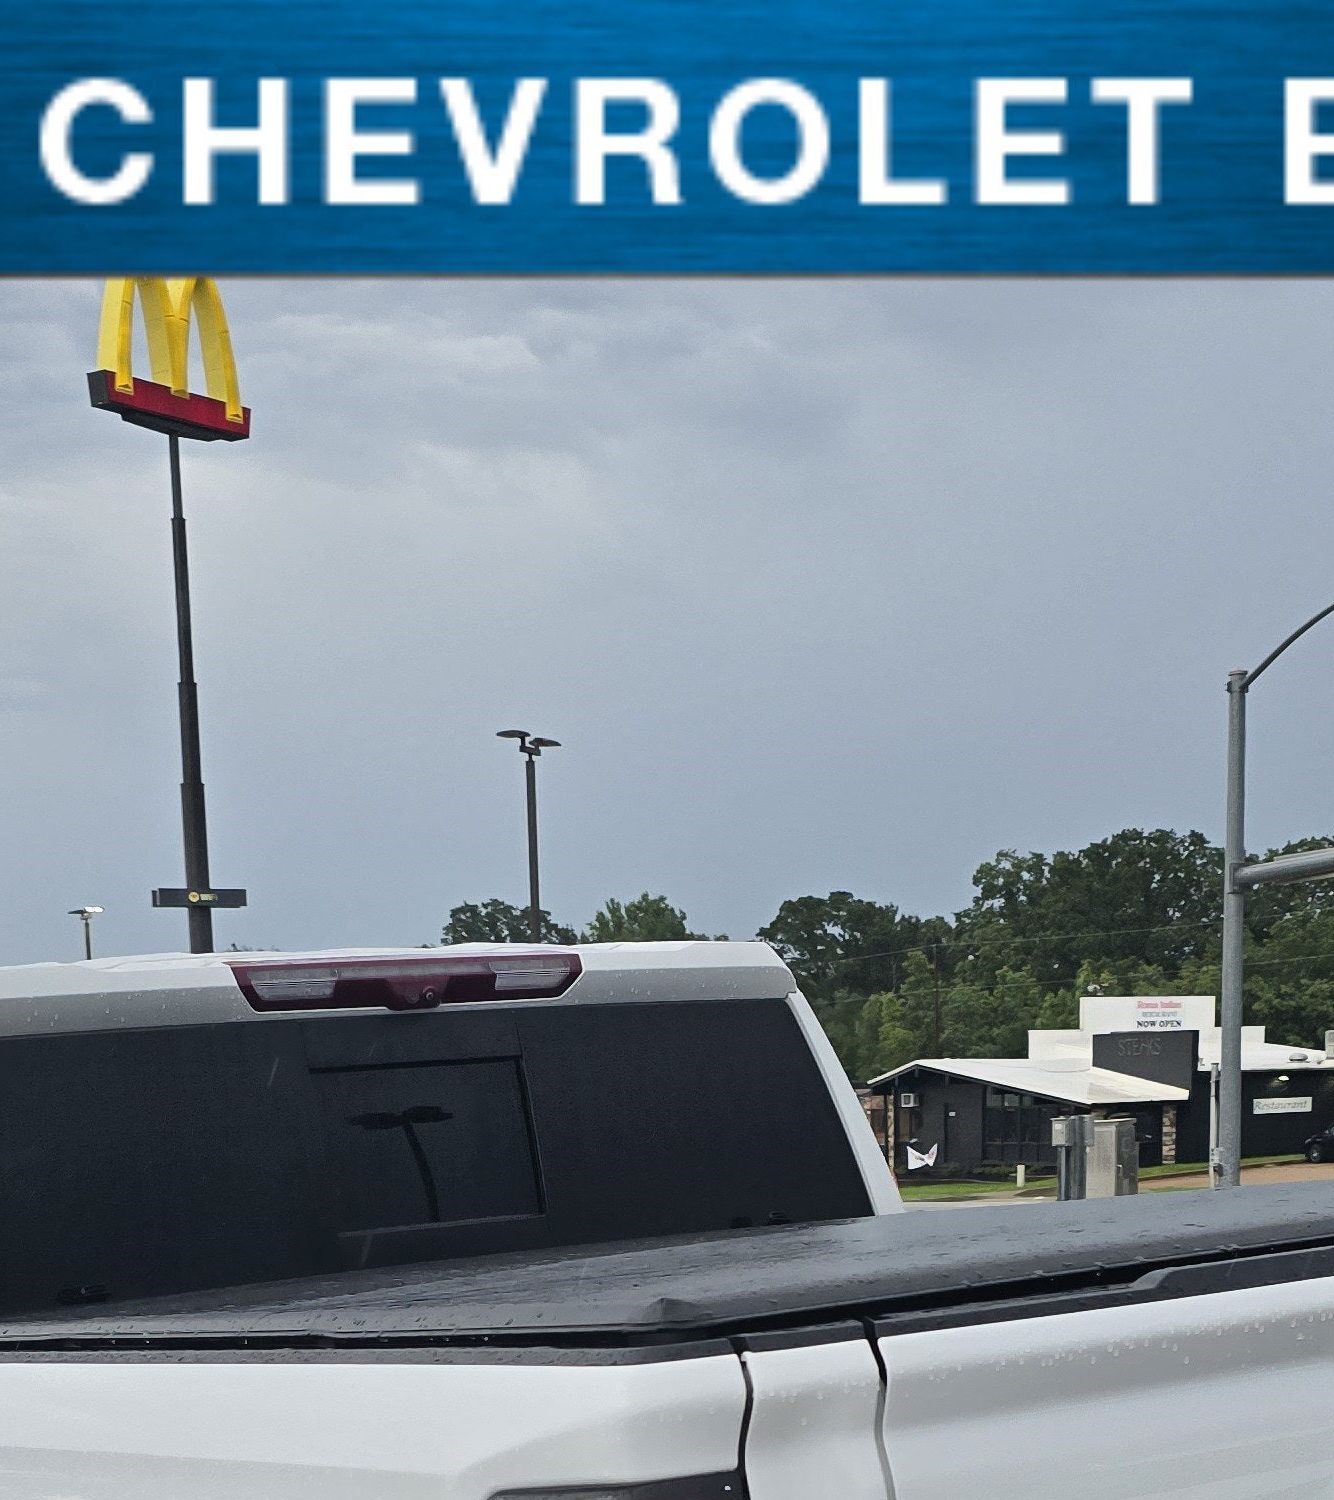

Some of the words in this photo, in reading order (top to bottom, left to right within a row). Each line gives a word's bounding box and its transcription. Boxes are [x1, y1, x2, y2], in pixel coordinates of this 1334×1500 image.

[1136, 1020, 1157, 1028] NOW
[1158, 1020, 1182, 1028] OPEN
[1254, 1100, 1309, 1111] Restaurant
